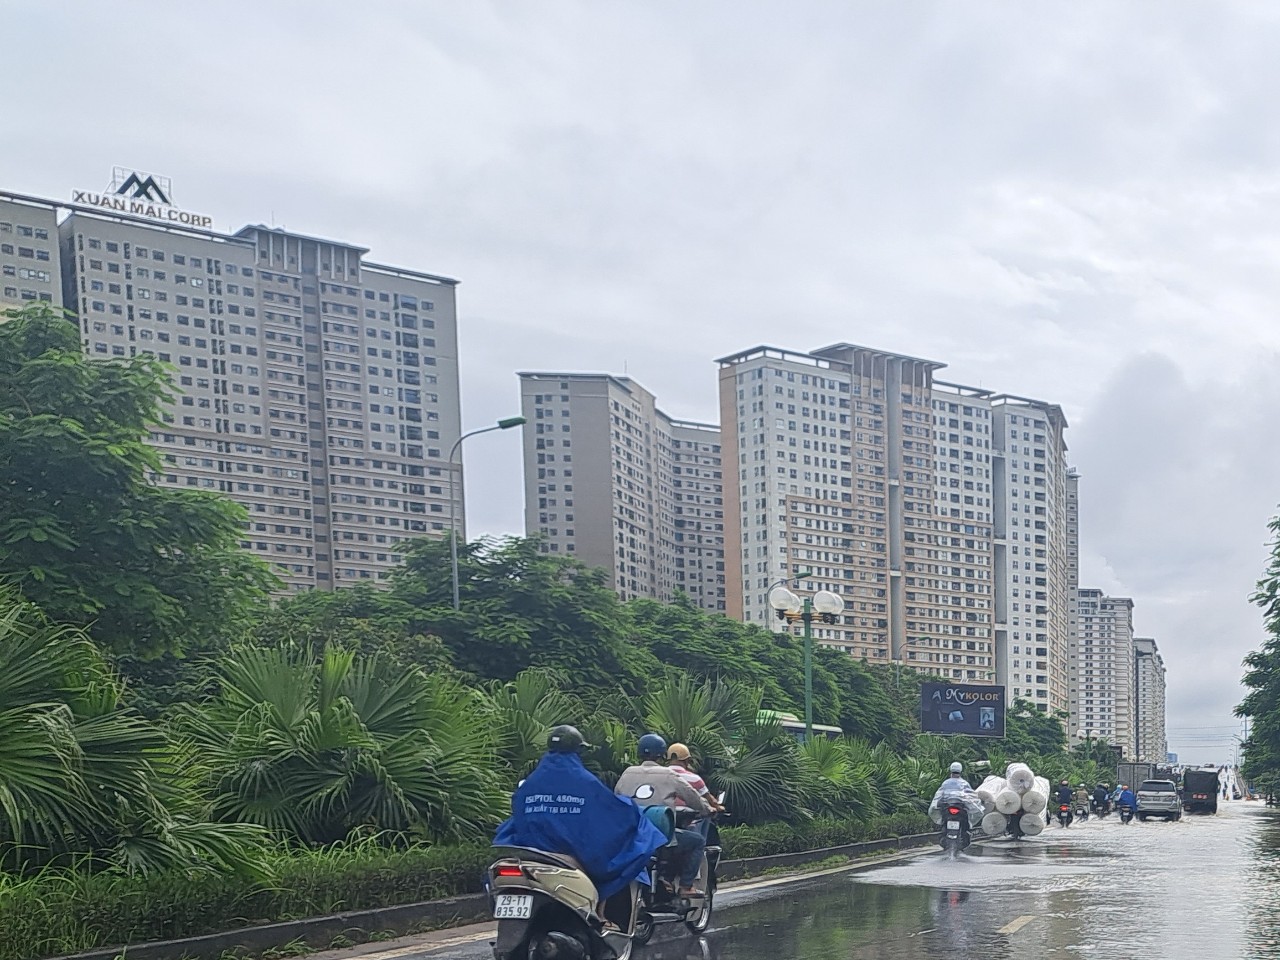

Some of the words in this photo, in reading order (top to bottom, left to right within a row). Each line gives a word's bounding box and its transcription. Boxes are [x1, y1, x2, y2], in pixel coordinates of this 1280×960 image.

[74, 190, 125, 211] XUAN
[130, 202, 163, 219] MAI
[168, 209, 212, 227] CORP
[945, 688, 999, 705] MYKOLOR
[501, 895, 527, 906] 29-T1
[496, 906, 528, 917] 835.92
